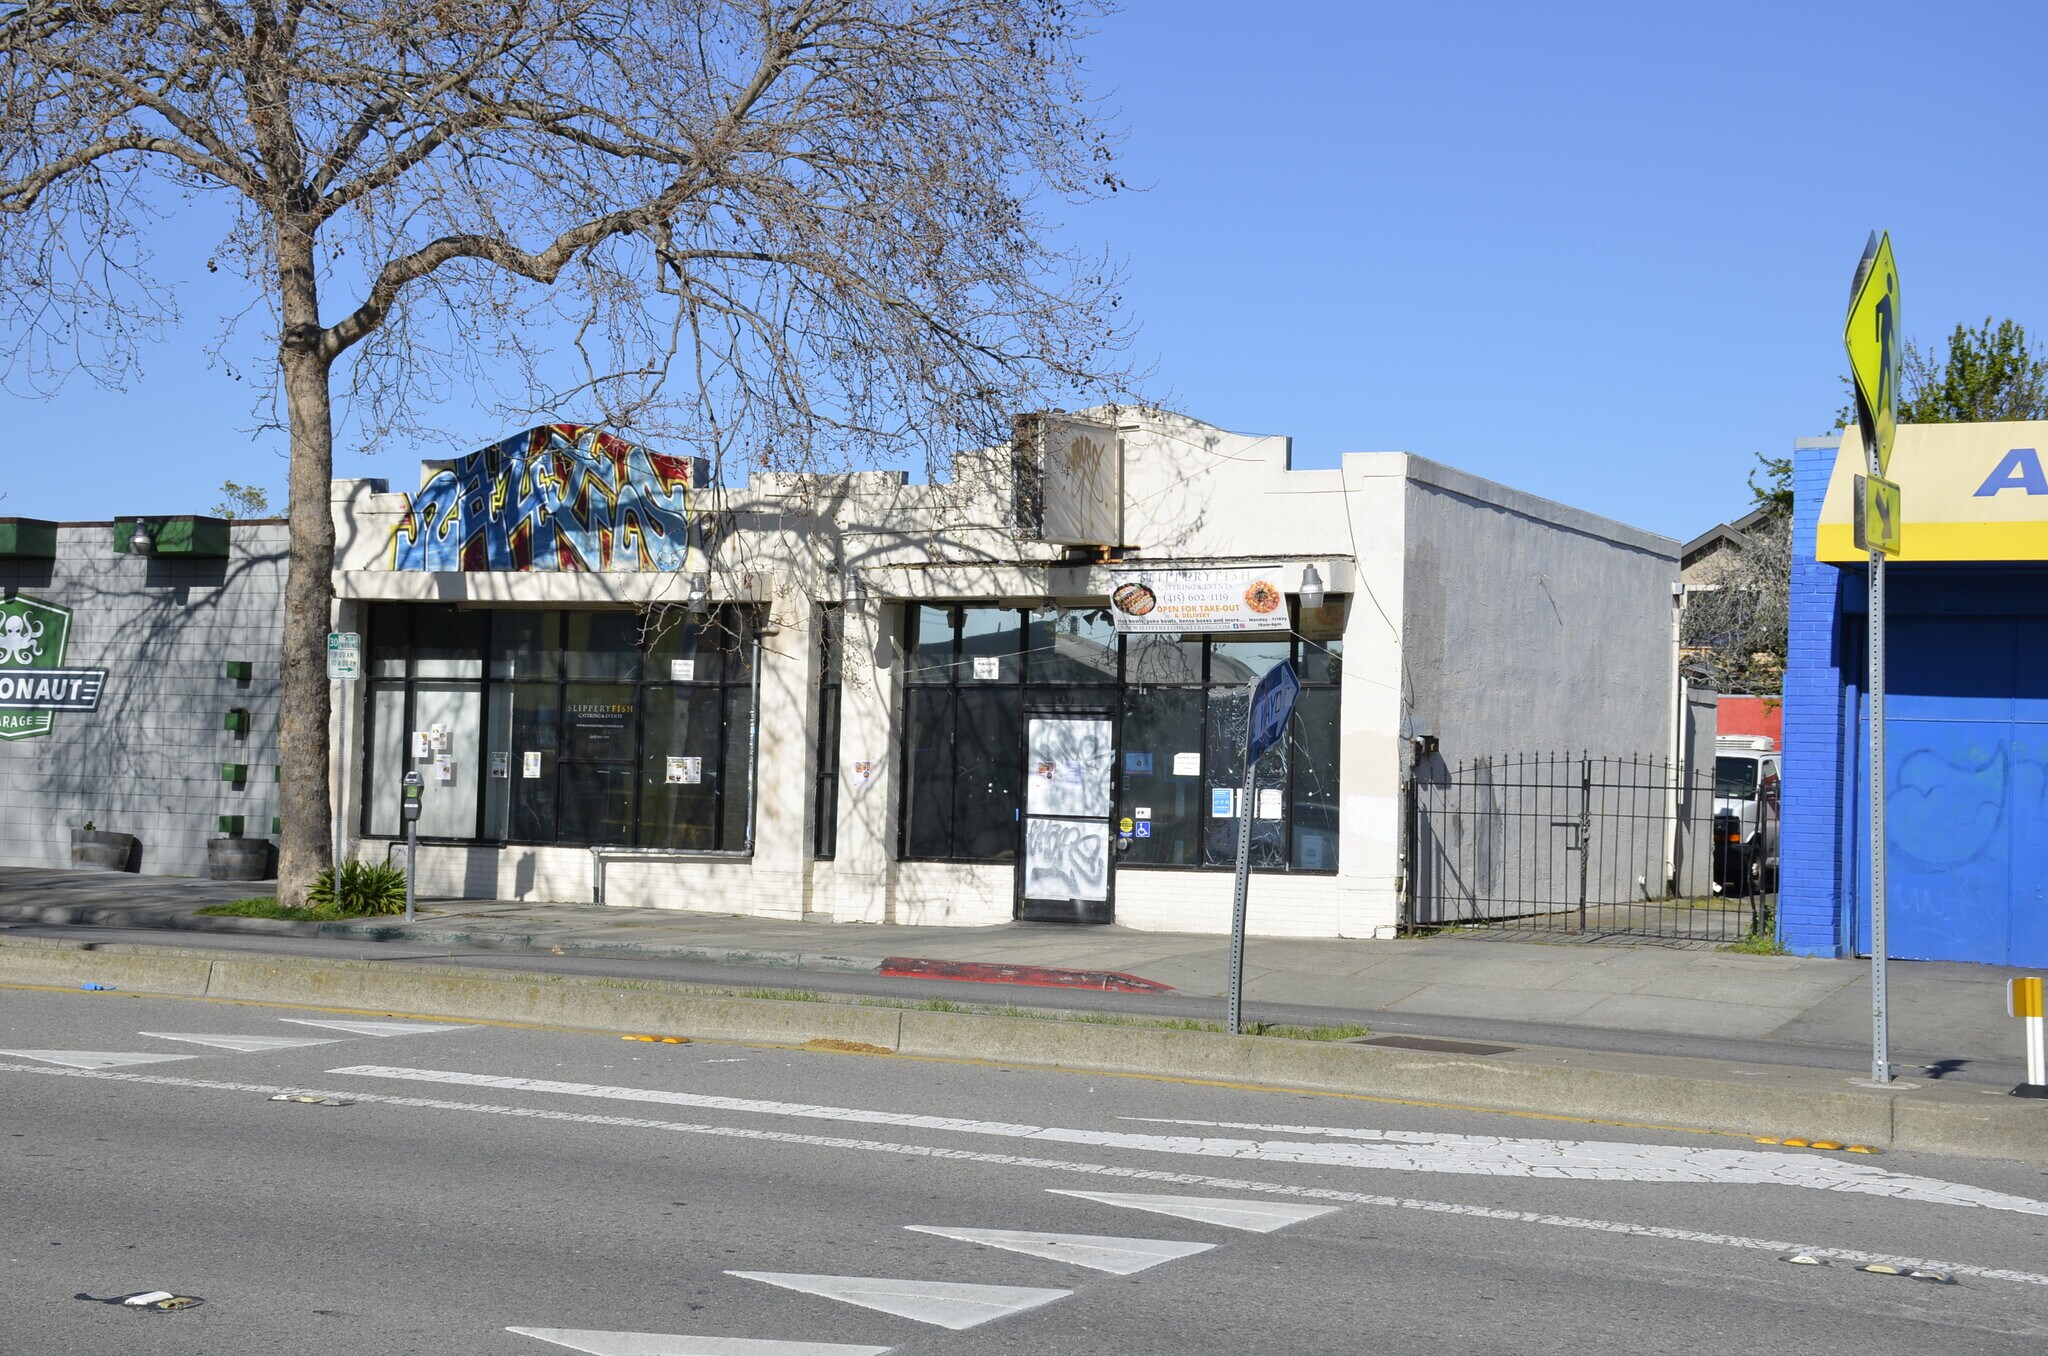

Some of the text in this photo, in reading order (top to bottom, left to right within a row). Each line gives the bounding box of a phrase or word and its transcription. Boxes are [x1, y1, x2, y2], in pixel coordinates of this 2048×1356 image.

[1972, 447, 2048, 497] A
[1163, 592, 1229, 605] (415) 602-1119
[1157, 604, 1240, 613] OPEN FOR TAKE-OUT
[330, 637, 338, 647] 30
[0, 677, 82, 700] ONAUT
[567, 704, 634, 713] SLIPPERYFISH
